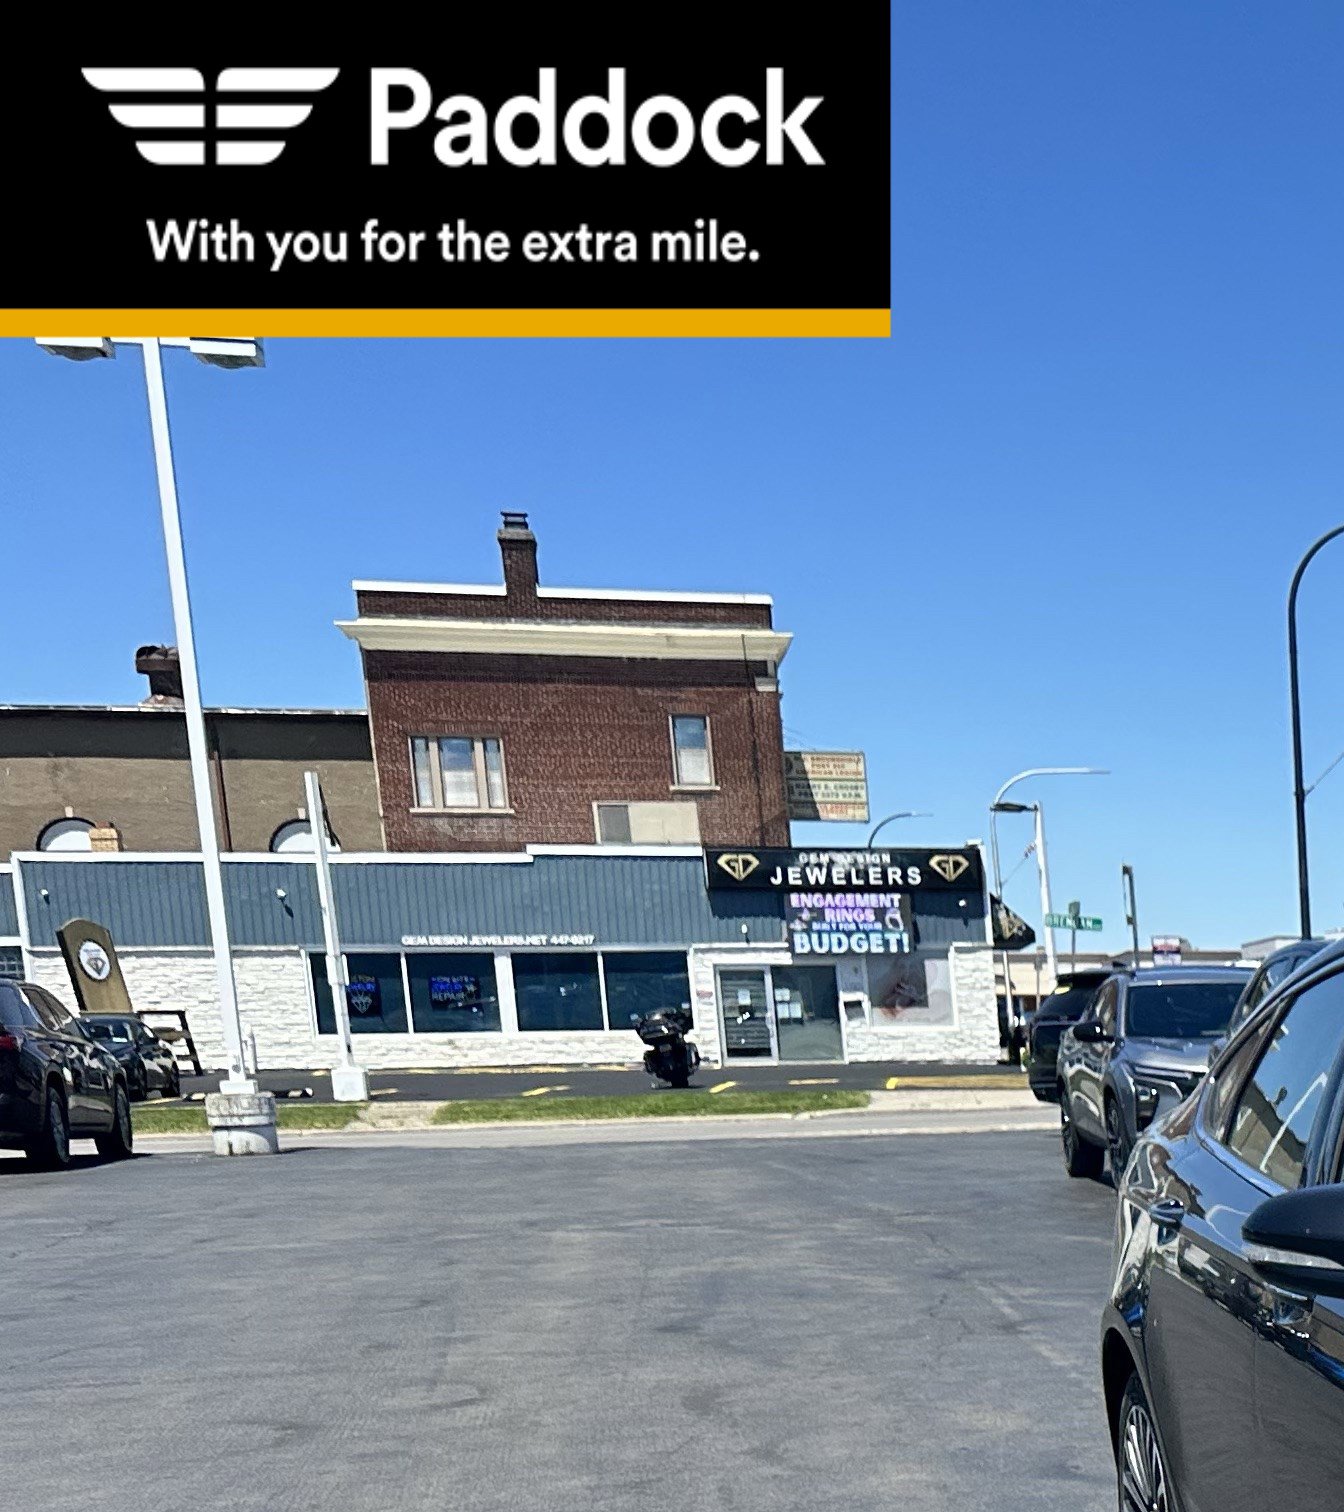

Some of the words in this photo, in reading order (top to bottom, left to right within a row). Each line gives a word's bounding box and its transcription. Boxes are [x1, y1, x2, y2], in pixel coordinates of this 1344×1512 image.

[769, 866, 922, 886] JEWELERS
[789, 892, 902, 908] ENGAGEMENT
[824, 907, 876, 922] RINGS
[792, 931, 910, 954] BUDGET!
